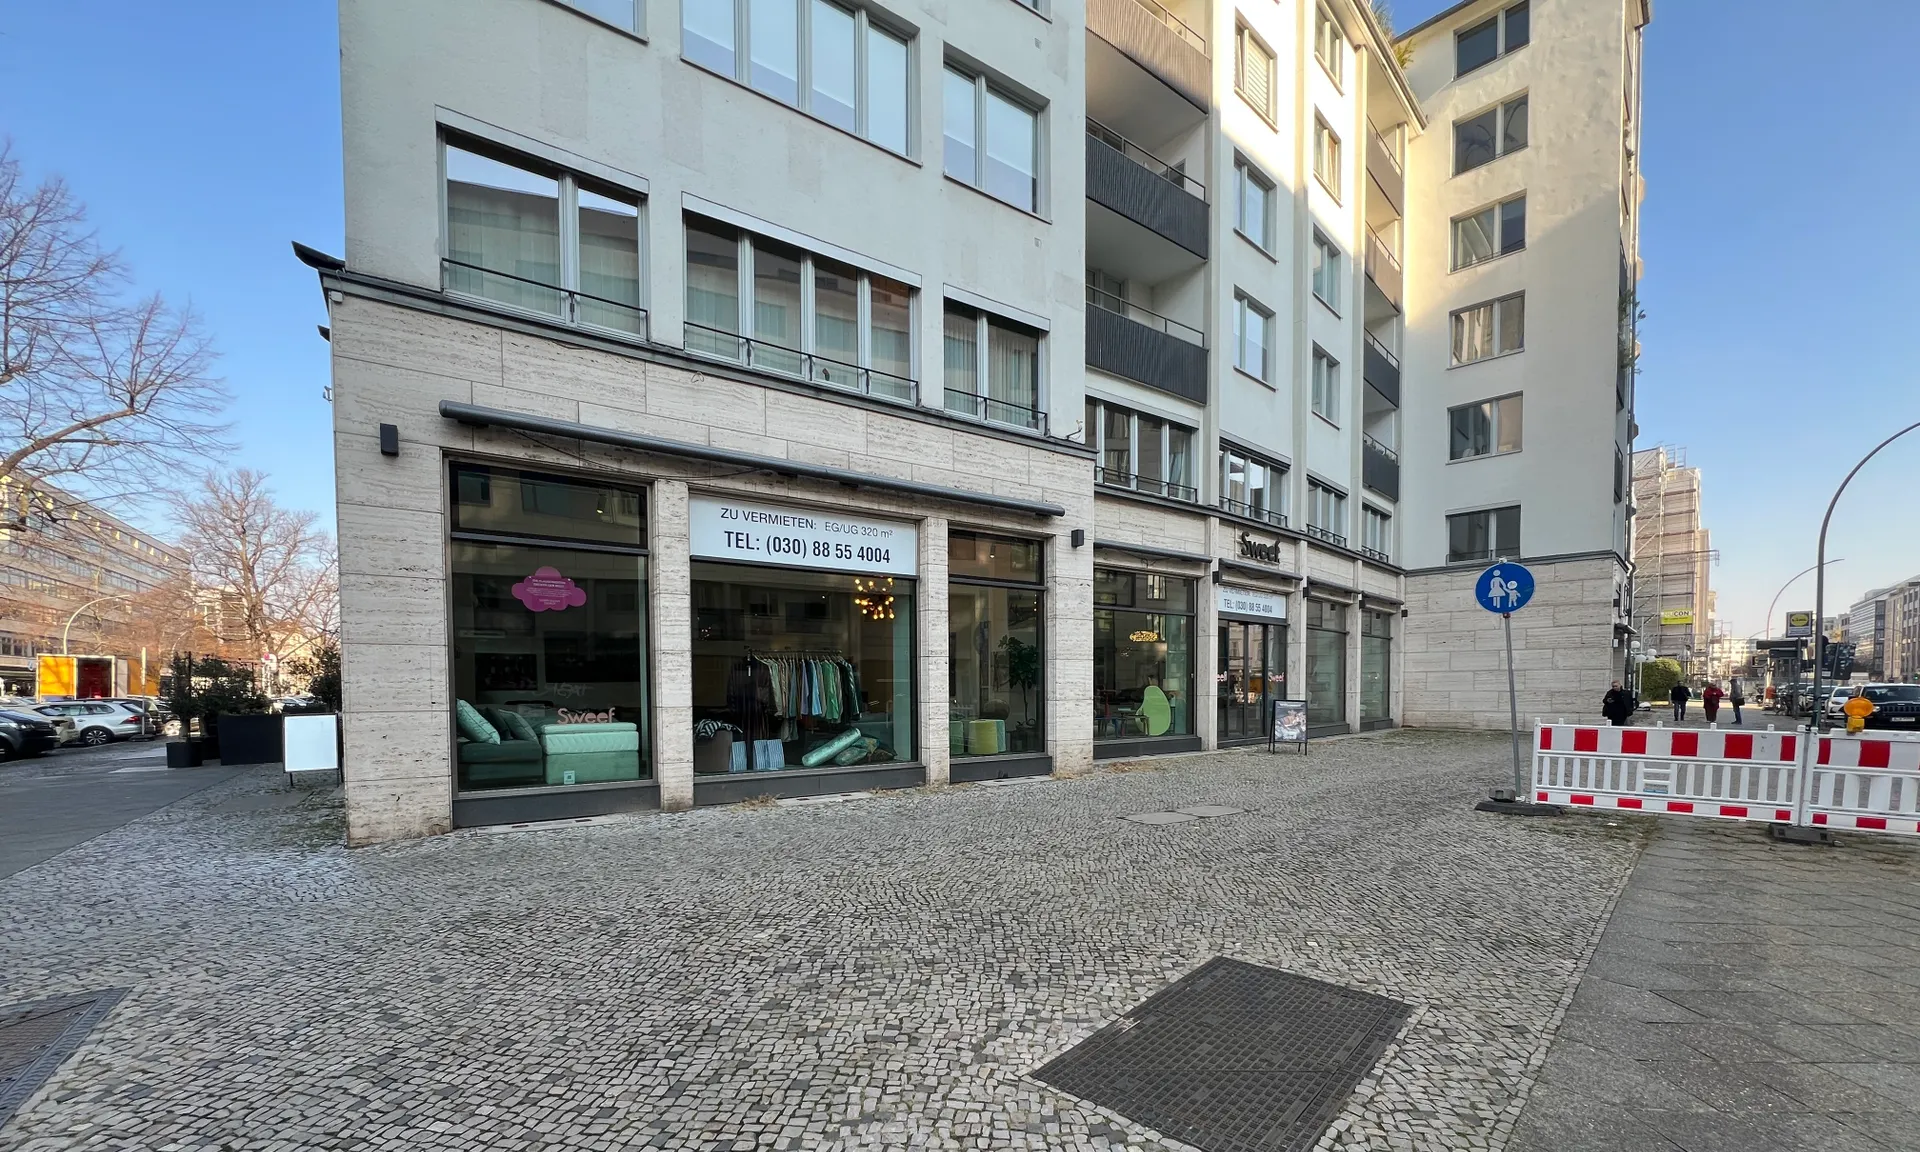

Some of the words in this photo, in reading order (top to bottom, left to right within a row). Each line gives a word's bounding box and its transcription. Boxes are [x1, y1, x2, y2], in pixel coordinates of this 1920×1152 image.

[720, 507, 739, 520] ZU
[742, 510, 817, 530] VERMIETEN:
[825, 521, 859, 535] EG/UG
[861, 526, 878, 537] 320
[724, 530, 760, 551] TEL:
[766, 535, 807, 559] (030)
[813, 540, 830, 557] 88
[835, 543, 852, 560] 55
[857, 546, 890, 563] 4004
[1223, 598, 1234, 609] TEL:
[557, 707, 616, 725] Sweef
